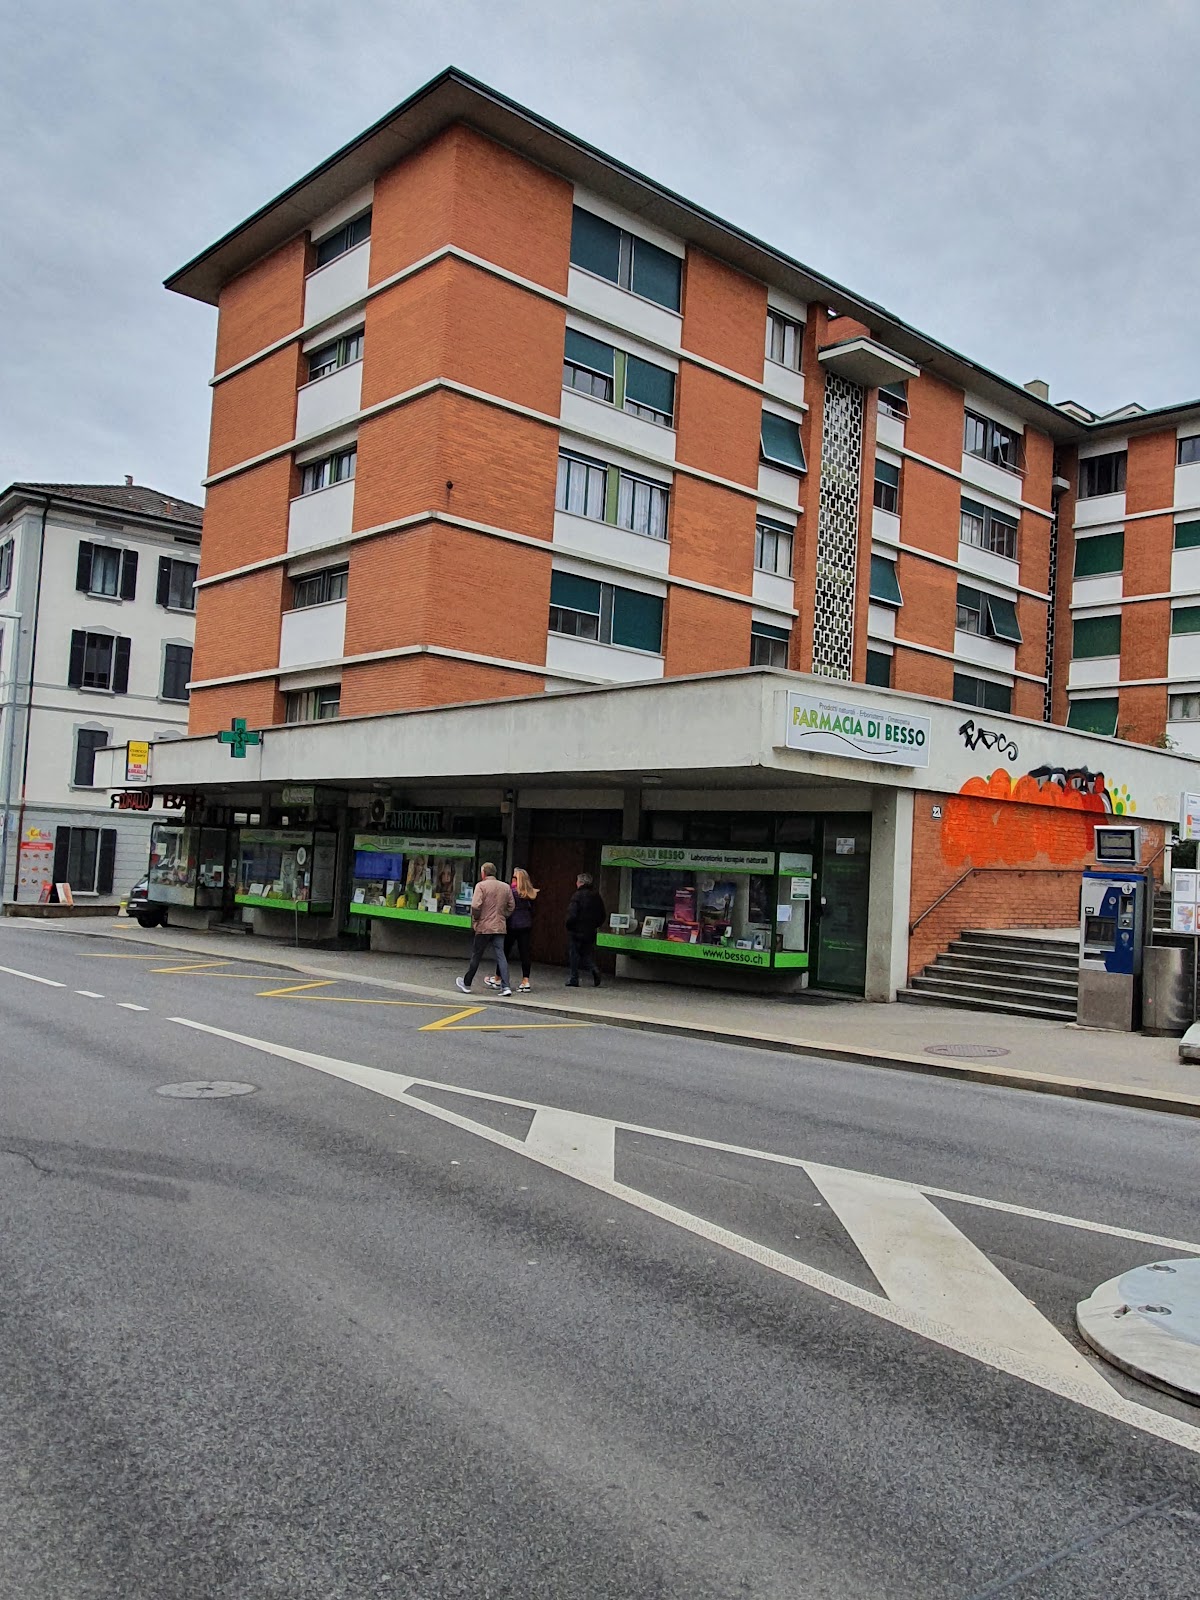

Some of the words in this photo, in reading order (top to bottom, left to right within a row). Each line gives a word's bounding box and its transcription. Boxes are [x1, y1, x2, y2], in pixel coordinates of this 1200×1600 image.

[792, 706, 864, 737] FARMACIA
[867, 720, 880, 739] DI
[885, 723, 926, 747] BESSO
[385, 811, 439, 831] FARMACIA
[658, 849, 685, 860] BESSO
[690, 853, 723, 863] Laboratorio
[702, 947, 763, 964] www.besso.ch
